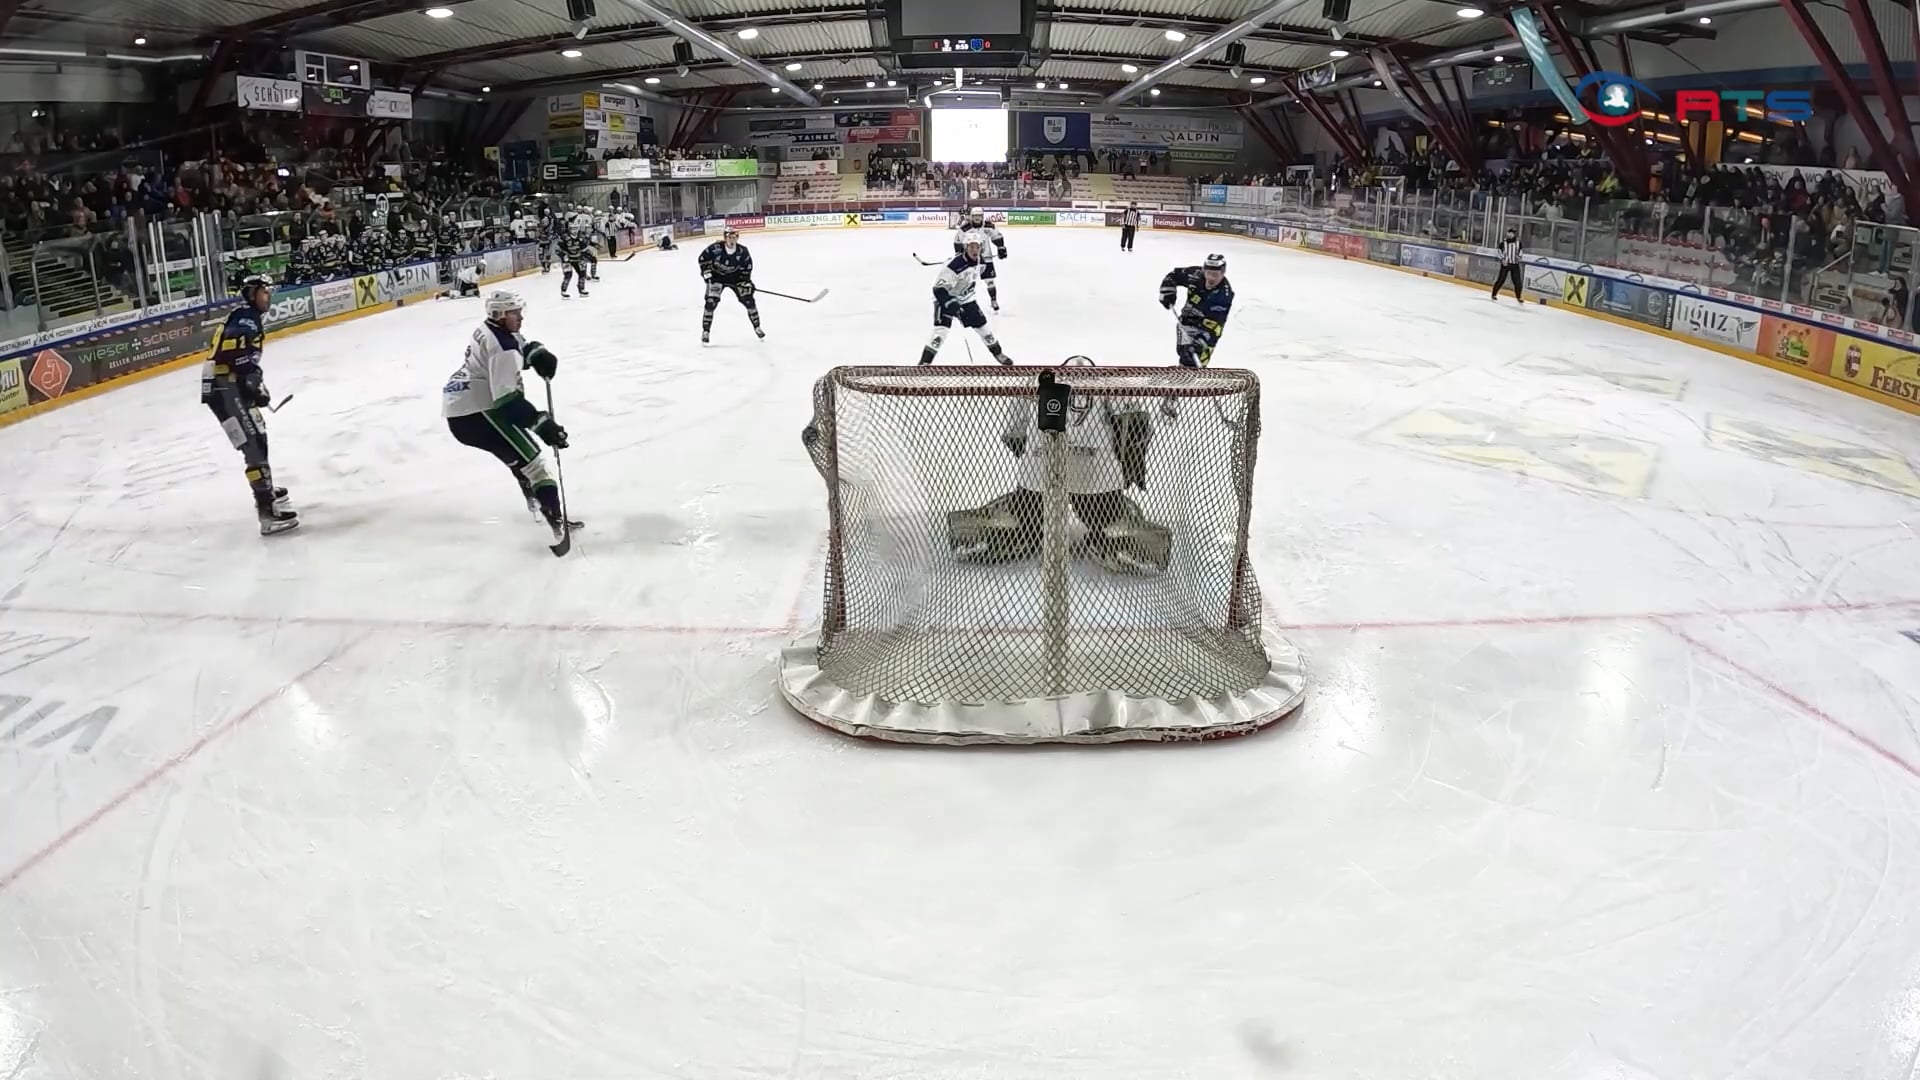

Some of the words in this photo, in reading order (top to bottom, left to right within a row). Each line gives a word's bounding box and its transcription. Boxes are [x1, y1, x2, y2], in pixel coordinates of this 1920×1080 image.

[1176, 133, 1220, 142] ALPIN
[78, 341, 130, 365] wieser
[143, 325, 195, 347] scherer
